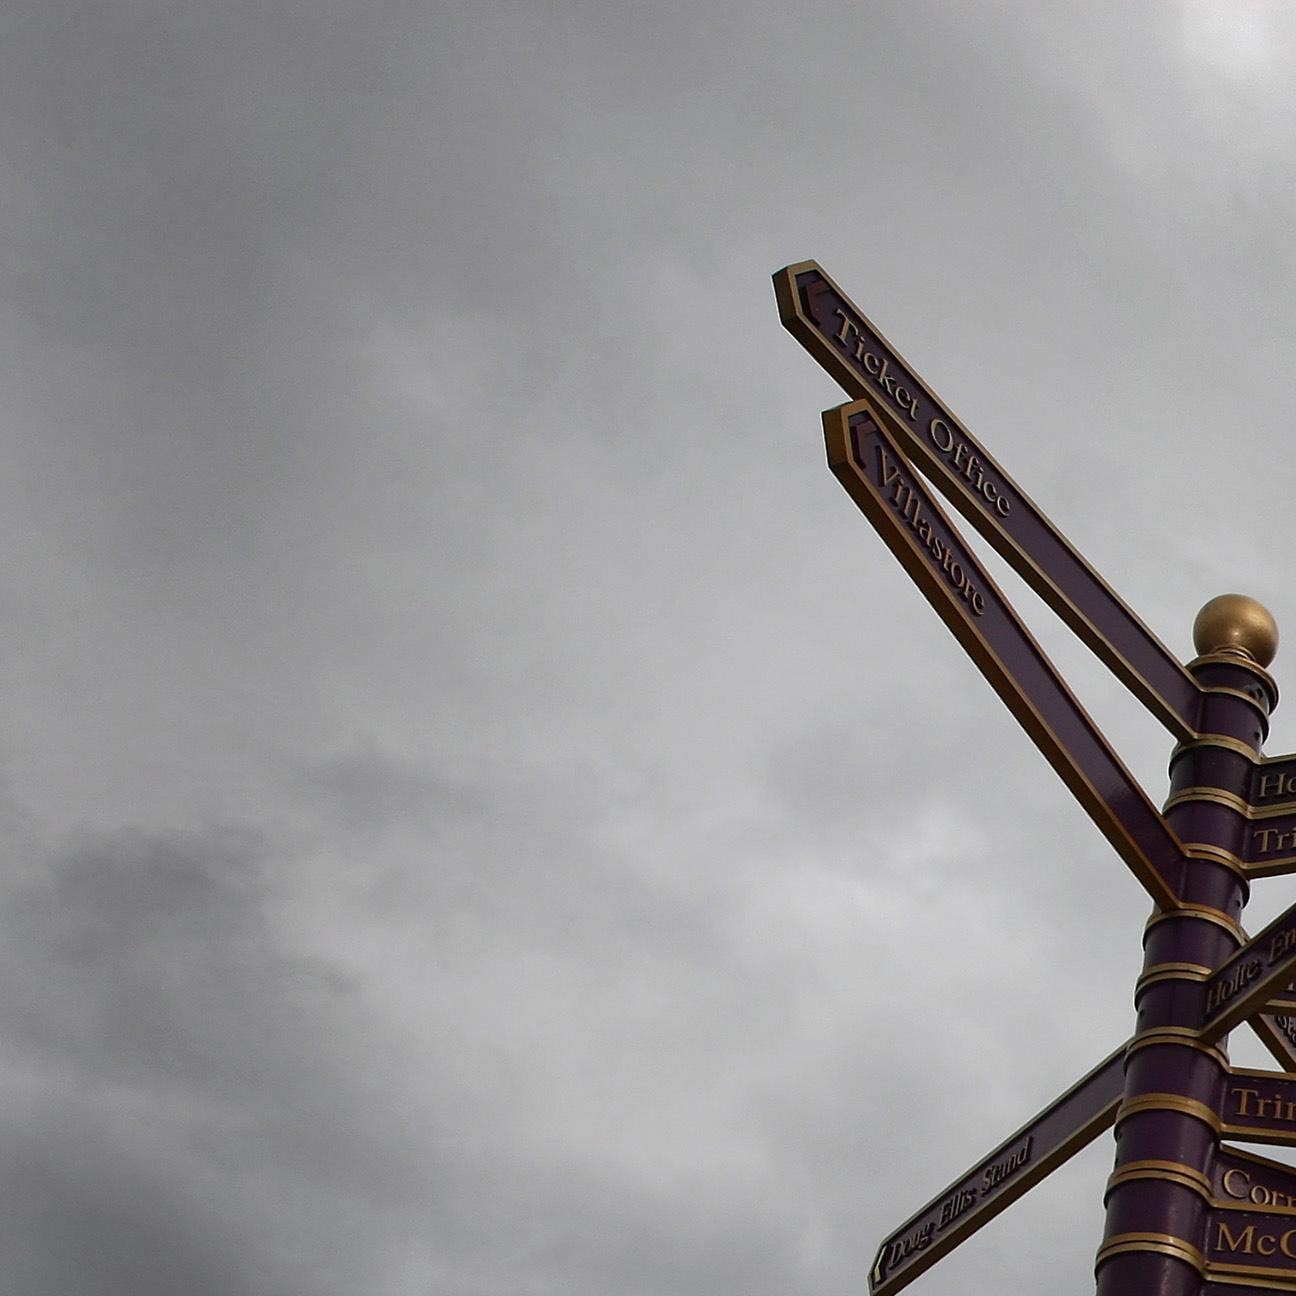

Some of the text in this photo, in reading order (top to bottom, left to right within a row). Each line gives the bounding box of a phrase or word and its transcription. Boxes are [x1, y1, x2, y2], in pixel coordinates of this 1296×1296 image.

[833, 308, 1011, 518] Ticket Office
[875, 445, 985, 617] Villastore
[1204, 957, 1262, 1015] Holte
[936, 1187, 977, 1232] Ellis
[981, 1136, 1035, 1198] Stand
